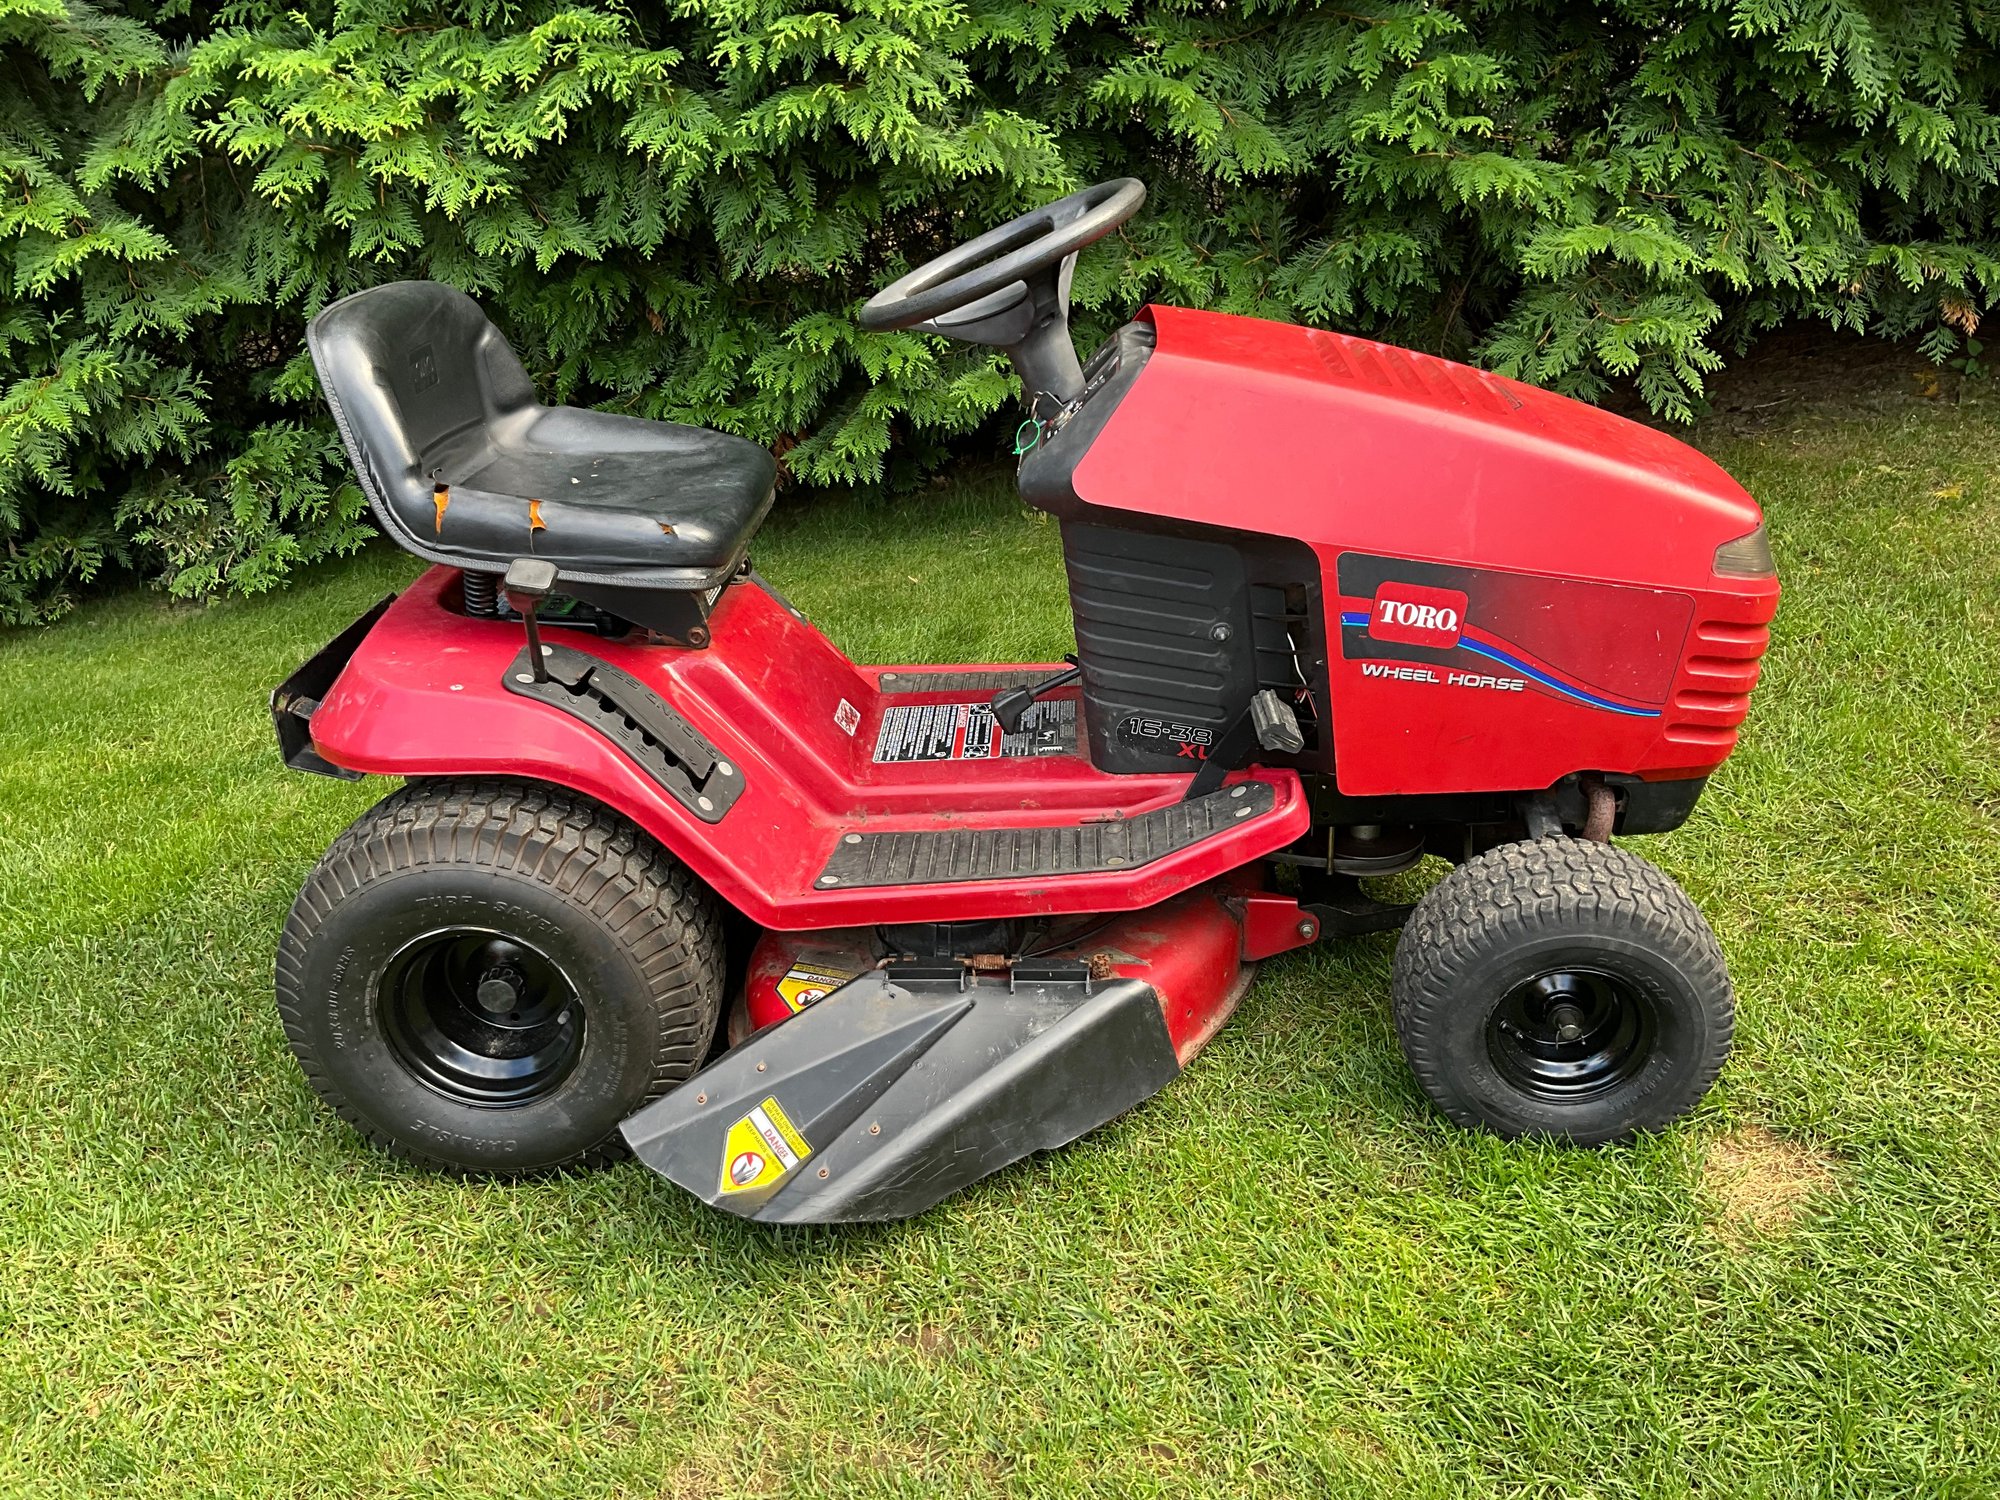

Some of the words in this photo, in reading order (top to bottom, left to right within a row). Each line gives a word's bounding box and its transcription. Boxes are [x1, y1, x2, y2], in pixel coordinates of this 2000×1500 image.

[1361, 663, 1440, 684] WHEEL
[1447, 672, 1528, 692] HORSE
[1130, 717, 1213, 746] 16-38
[807, 974, 845, 986] DANGER
[764, 1129, 788, 1159] DANGER
